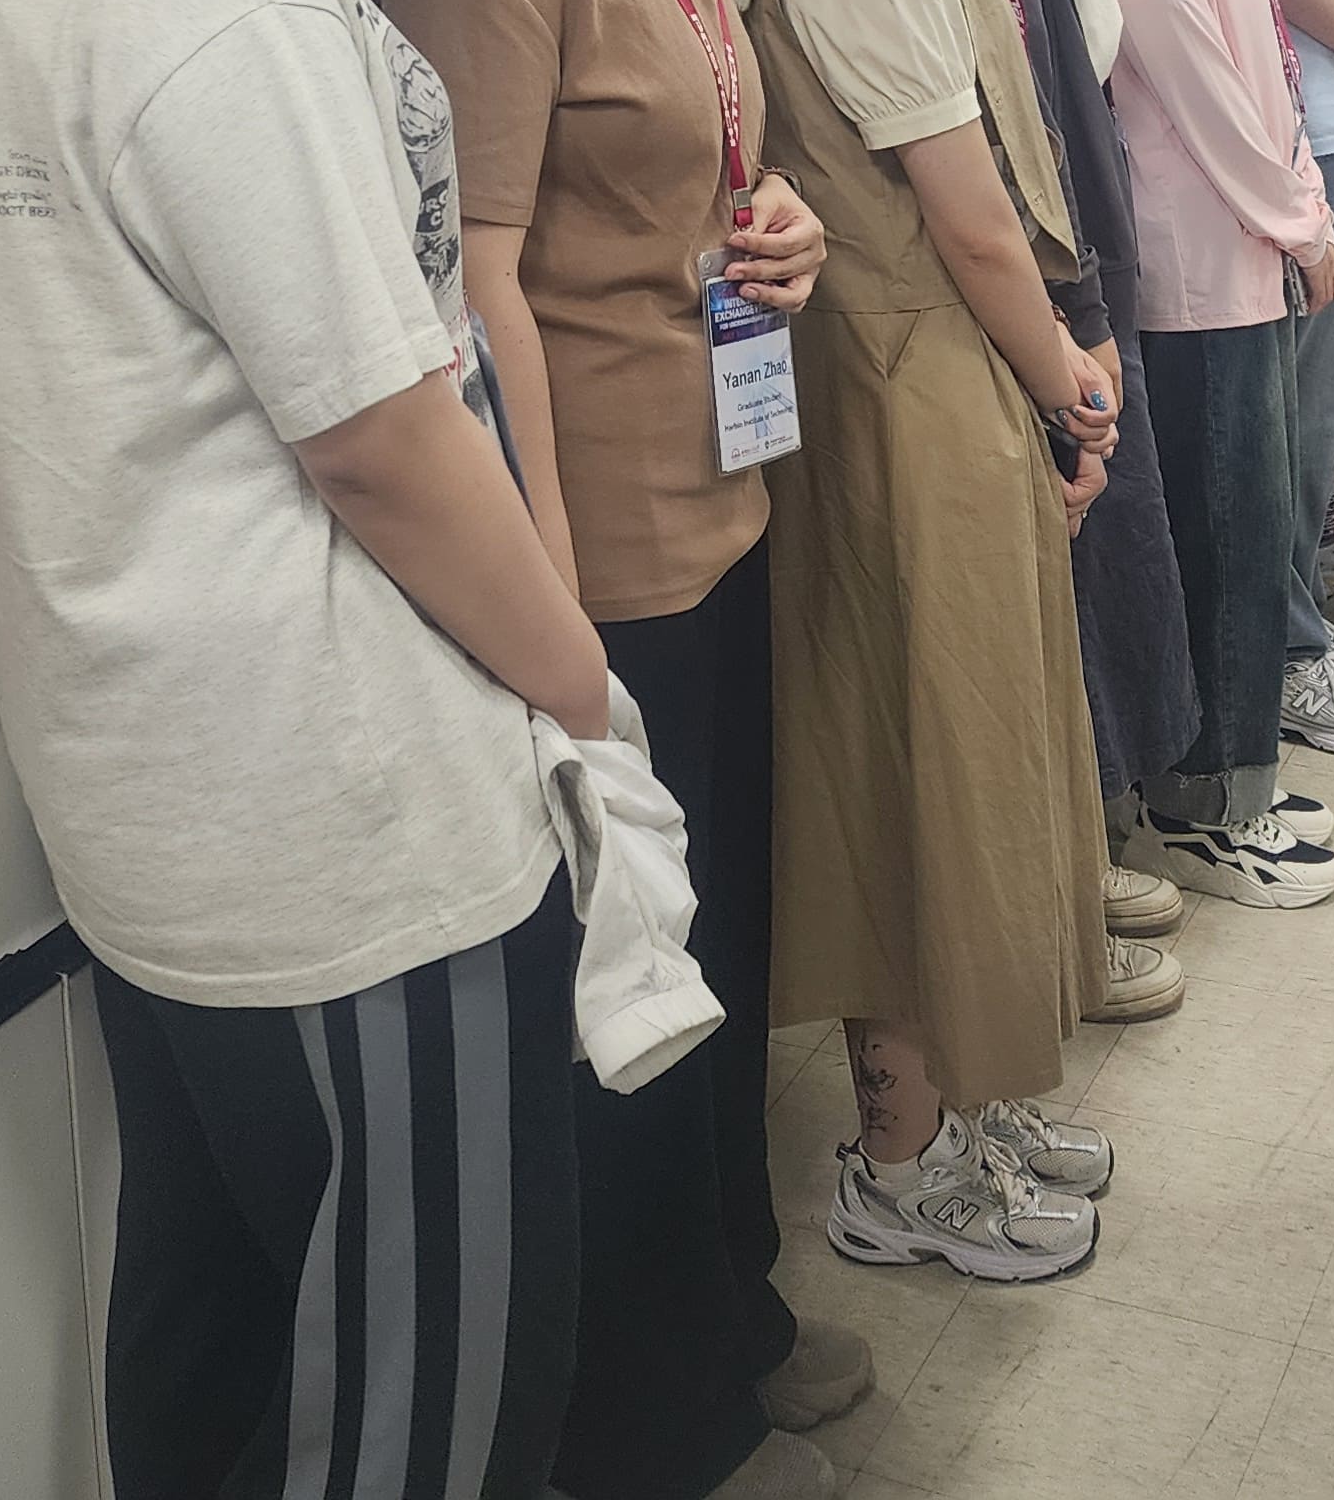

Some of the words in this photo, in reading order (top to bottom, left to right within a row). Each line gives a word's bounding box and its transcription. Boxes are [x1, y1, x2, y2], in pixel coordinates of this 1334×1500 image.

[714, 304, 755, 323] EXCHANGE
[722, 368, 762, 391] Yanan
[763, 359, 788, 380] Zhao
[737, 398, 763, 412] Graduate
